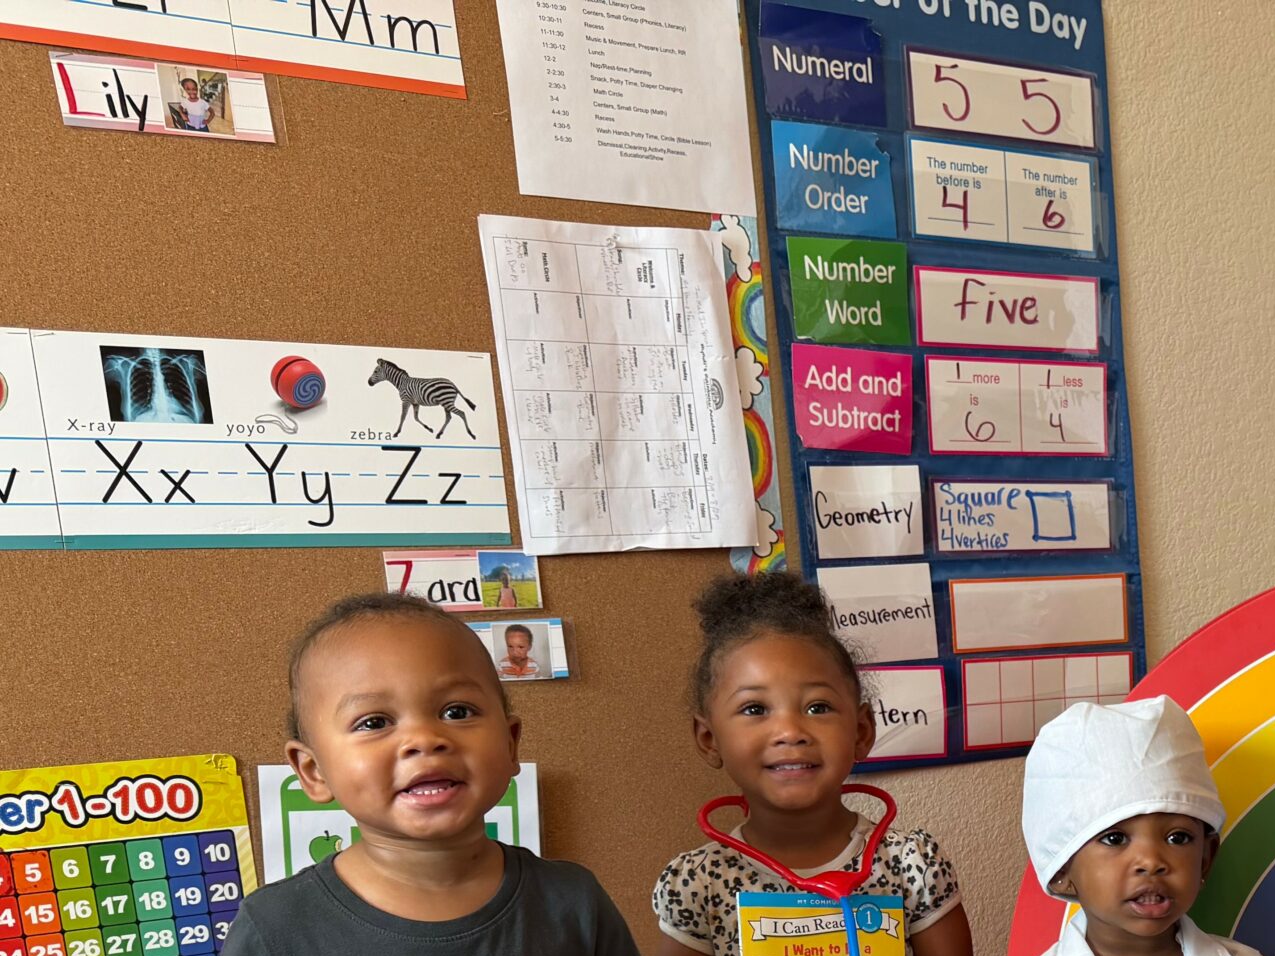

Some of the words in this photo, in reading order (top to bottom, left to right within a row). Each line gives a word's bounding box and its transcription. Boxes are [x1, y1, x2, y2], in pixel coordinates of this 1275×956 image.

[1029, 1, 1088, 51] Day
[772, 44, 873, 85] Numeral
[56, 62, 149, 132] Lily
[934, 64, 971, 122] 5
[1020, 78, 1062, 135] 5
[788, 143, 879, 179] Number
[926, 156, 946, 171] The
[948, 159, 989, 176] number
[935, 173, 970, 189] before
[973, 176, 982, 190] is
[1021, 168, 1040, 183] The
[1042, 171, 1079, 186] number
[804, 183, 869, 215] Order
[1034, 185, 1057, 199] after
[1059, 187, 1068, 200] is
[942, 186, 969, 231] 4
[1042, 201, 1066, 230] 6
[804, 256, 896, 285] Number
[825, 299, 882, 327] Word
[803, 364, 852, 392] Add
[858, 372, 902, 397] and
[972, 373, 1001, 385] more
[1062, 376, 1083, 388] less
[969, 395, 979, 407] is
[66, 417, 117, 435] X-ray
[225, 422, 266, 437] yoyo
[808, 401, 901, 433] Subtract
[965, 411, 996, 442] 6
[1049, 413, 1065, 442] 4
[350, 427, 393, 442] zebra
[814, 490, 914, 535] Geometry
[939, 482, 1022, 517] Square
[940, 507, 952, 527] 4
[957, 509, 996, 527] lines
[24, 863, 42, 882] 5
[61, 859, 80, 878] 6
[100, 854, 117, 874] 7
[138, 851, 155, 870] 8
[174, 847, 191, 866] 9
[203, 843, 231, 863] 10
[773, 921, 779, 934] I
[782, 921, 810, 935] Can
[866, 911, 873, 925] 1
[784, 945, 789, 956] I
[792, 944, 825, 956] Want
[828, 943, 841, 954] to
